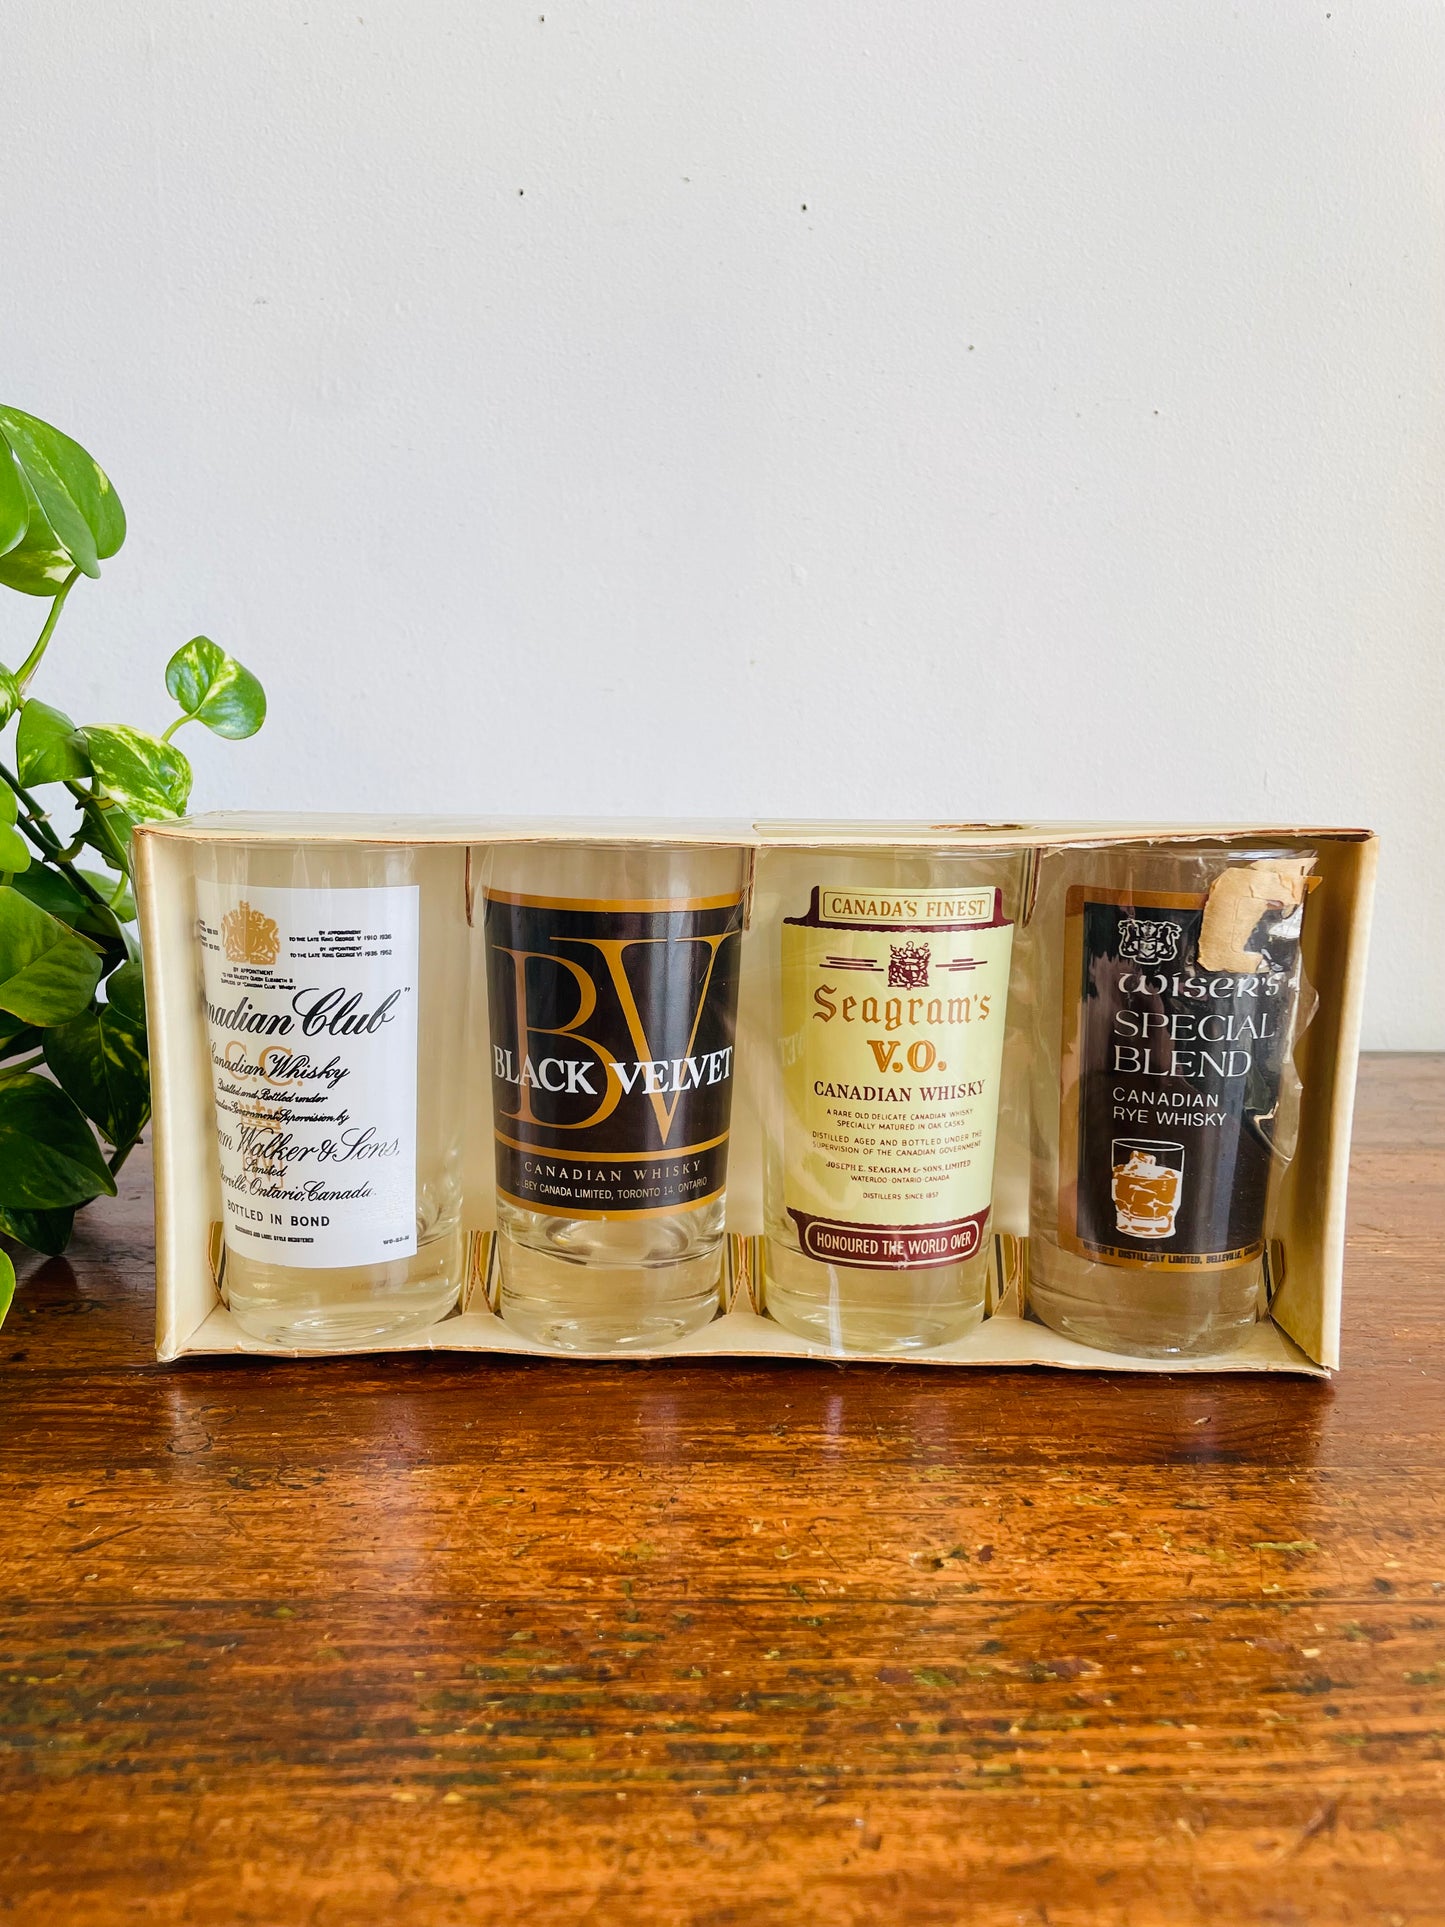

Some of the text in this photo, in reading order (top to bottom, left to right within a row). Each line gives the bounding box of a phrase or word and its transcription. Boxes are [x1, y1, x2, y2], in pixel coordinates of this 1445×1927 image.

[832, 897, 986, 918] CANADA'S FINEST
[208, 995, 294, 1036] nadian
[812, 983, 992, 1031] Seagram's
[1113, 1010, 1276, 1042] SPECIAL
[867, 1039, 948, 1073] V.O.
[1113, 1045, 1252, 1078] BLEND
[268, 1054, 351, 1089] Whisky
[493, 1044, 598, 1095] BLACK
[608, 1045, 733, 1095] VELVET
[814, 1079, 986, 1102] CANADIAN WHISKY
[1112, 1086, 1219, 1108] CANADIAN
[833, 1109, 852, 1118] RARE
[871, 1113, 907, 1121] DELICATE
[910, 1112, 947, 1120] CANADIAN
[948, 1108, 974, 1117] WHISKY
[836, 1119, 876, 1130] SPECIALLY
[878, 1123, 915, 1131] MATURED
[927, 1122, 943, 1130] OAK
[944, 1119, 966, 1128] CASKS
[1113, 1106, 1227, 1127] RYE WHISKY
[236, 1122, 320, 1163] Walker
[317, 1139, 338, 1163] &
[812, 1129, 983, 1147] DISTILLED AGED AND BOTTLED UNDER THE
[812, 1139, 982, 1156] SUPERVISION OF THE CANADIAN GOVERNMENT
[244, 1157, 288, 1178] Limited
[524, 1160, 701, 1182] CANADIAN WHISKY
[825, 1160, 856, 1171] JOSEPH
[868, 1166, 911, 1174] SEAGRAM
[944, 1159, 972, 1171] LIMITED
[539, 1183, 572, 1197] CANADA
[574, 1188, 614, 1200] LIMITED,
[617, 1187, 661, 1199] TORONTO
[677, 1176, 708, 1193] ONTARIO
[850, 1174, 887, 1183] WATERLOO
[924, 1174, 950, 1183] CANADA
[862, 1192, 901, 1200] DISTILLERS
[904, 1192, 924, 1200] SINCE
[227, 1200, 330, 1227] BOTTLED IN BOND
[816, 1231, 971, 1256] HONOURED THE WORLD OVER
